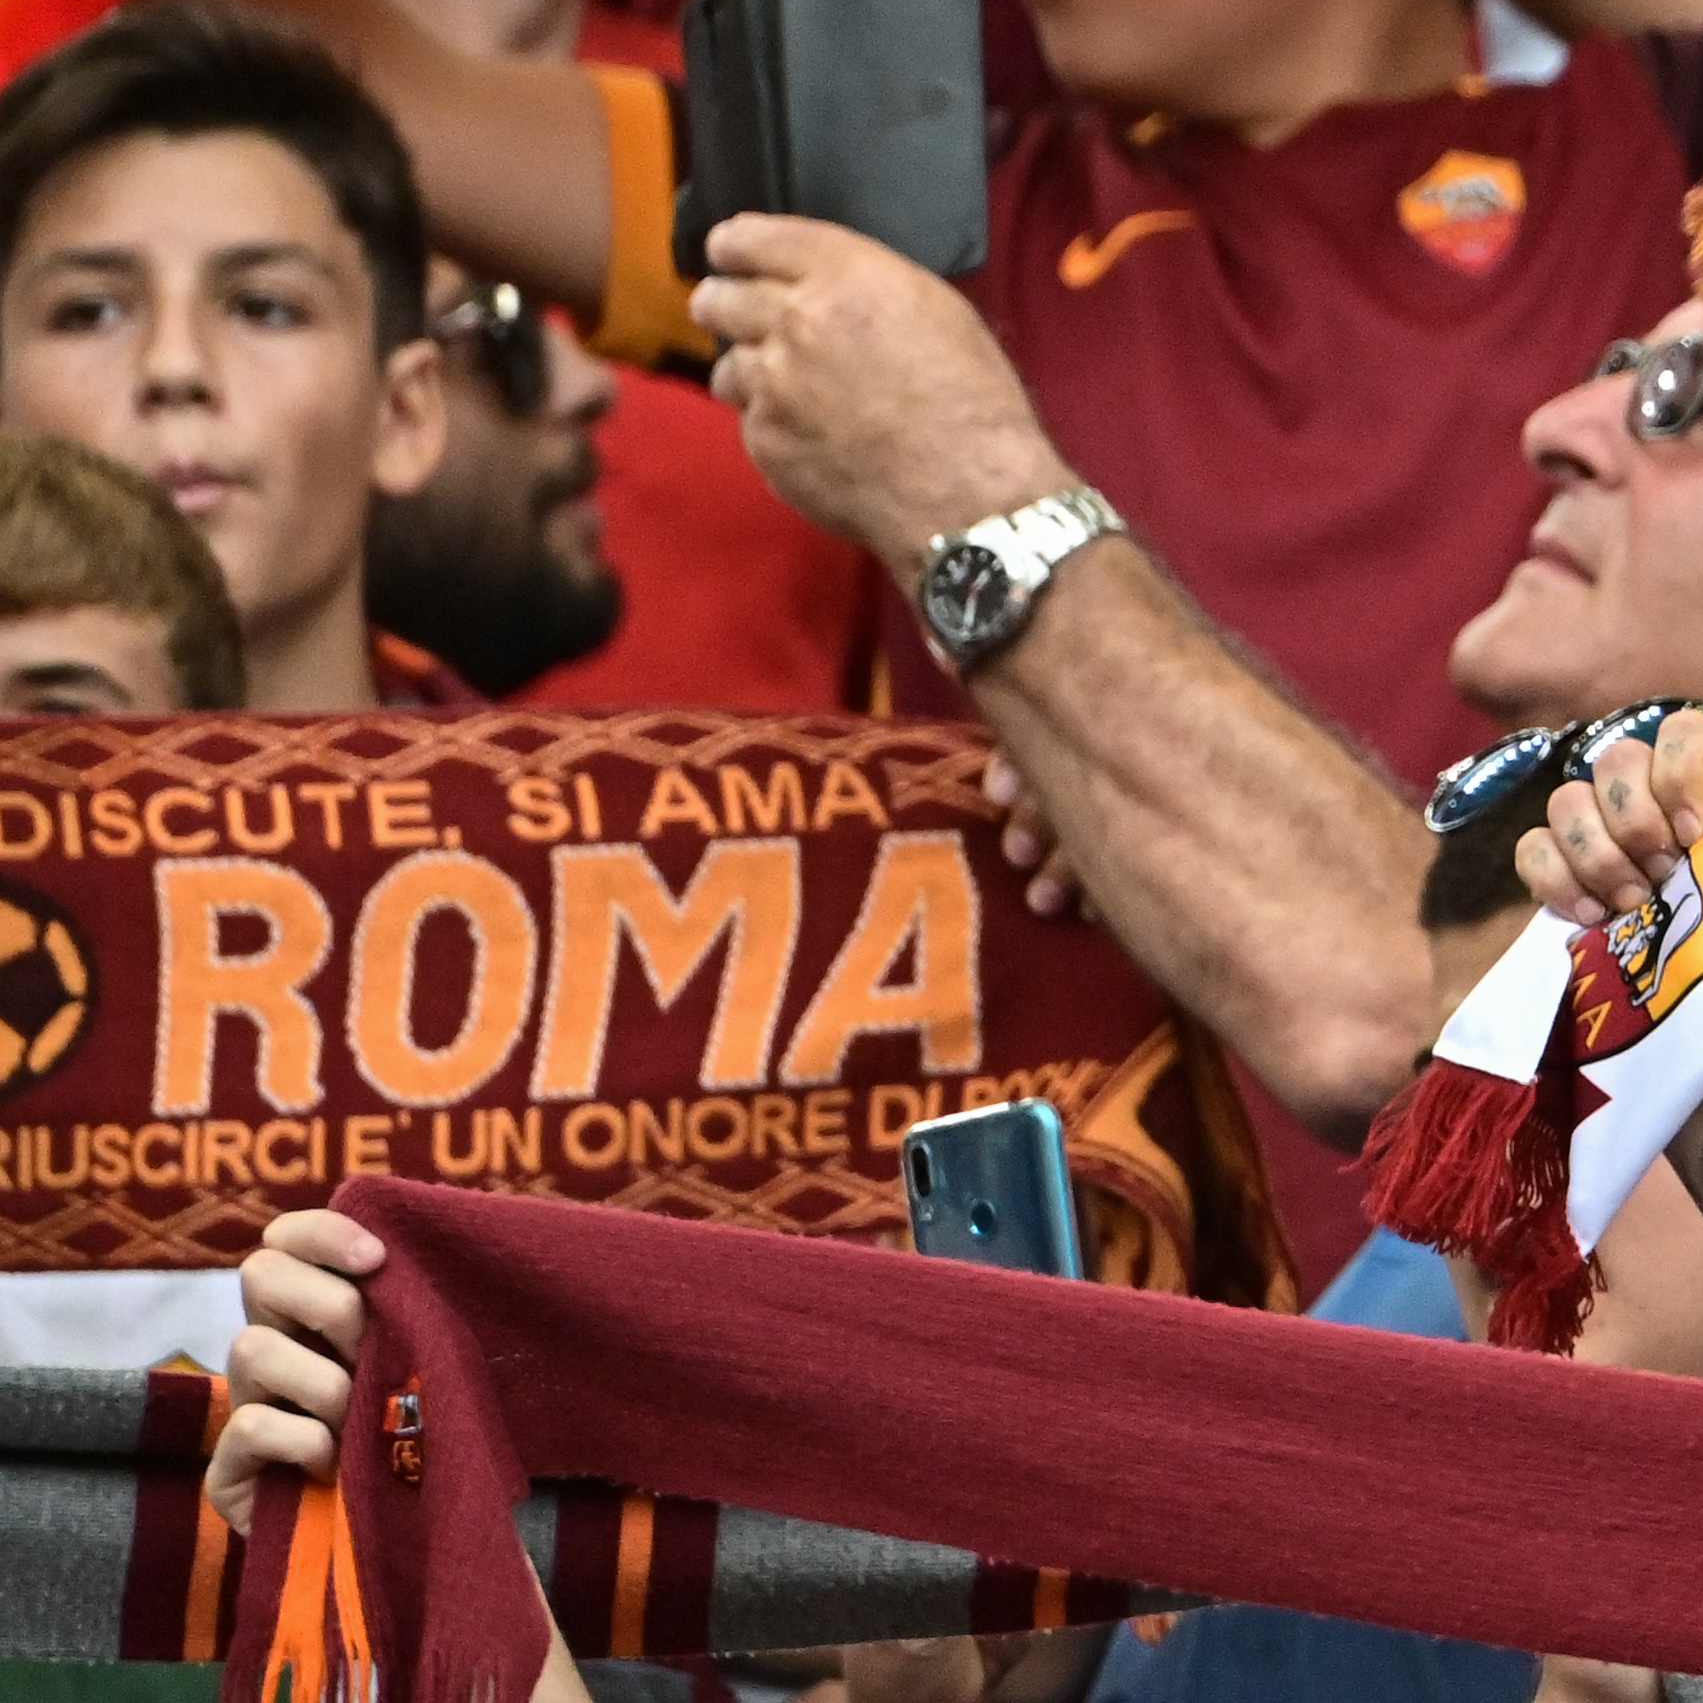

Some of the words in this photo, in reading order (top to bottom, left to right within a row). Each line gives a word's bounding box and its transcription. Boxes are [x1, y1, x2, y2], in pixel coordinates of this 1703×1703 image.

[506, 771, 601, 841] SI
[638, 759, 891, 838] AMA
[151, 828, 983, 1118] ROMA
[431, 1106, 543, 1177] UN
[561, 1088, 853, 1170] ONORE
